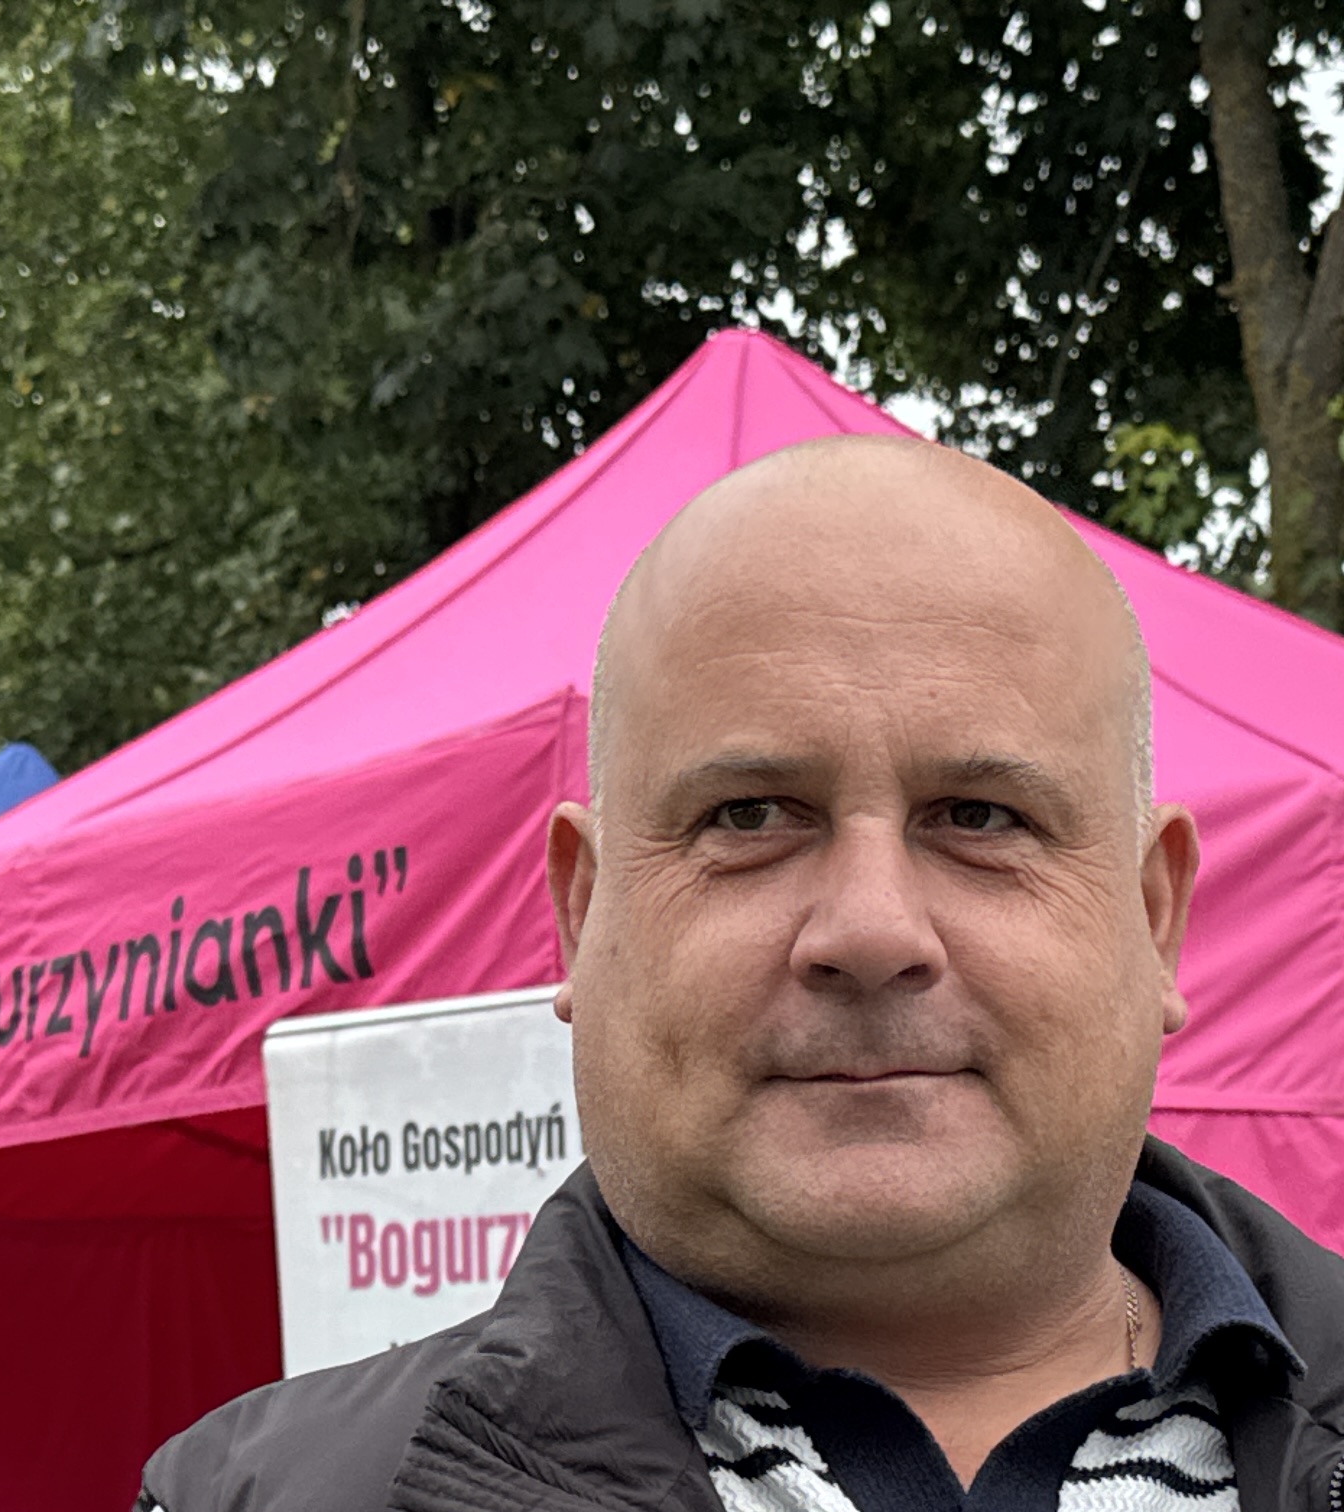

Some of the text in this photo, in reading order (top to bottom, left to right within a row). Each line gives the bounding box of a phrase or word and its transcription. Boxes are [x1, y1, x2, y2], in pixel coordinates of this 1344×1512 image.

[318, 1101, 566, 1180] Koło Gospodyń
[320, 1211, 531, 1298] "Bogurz
